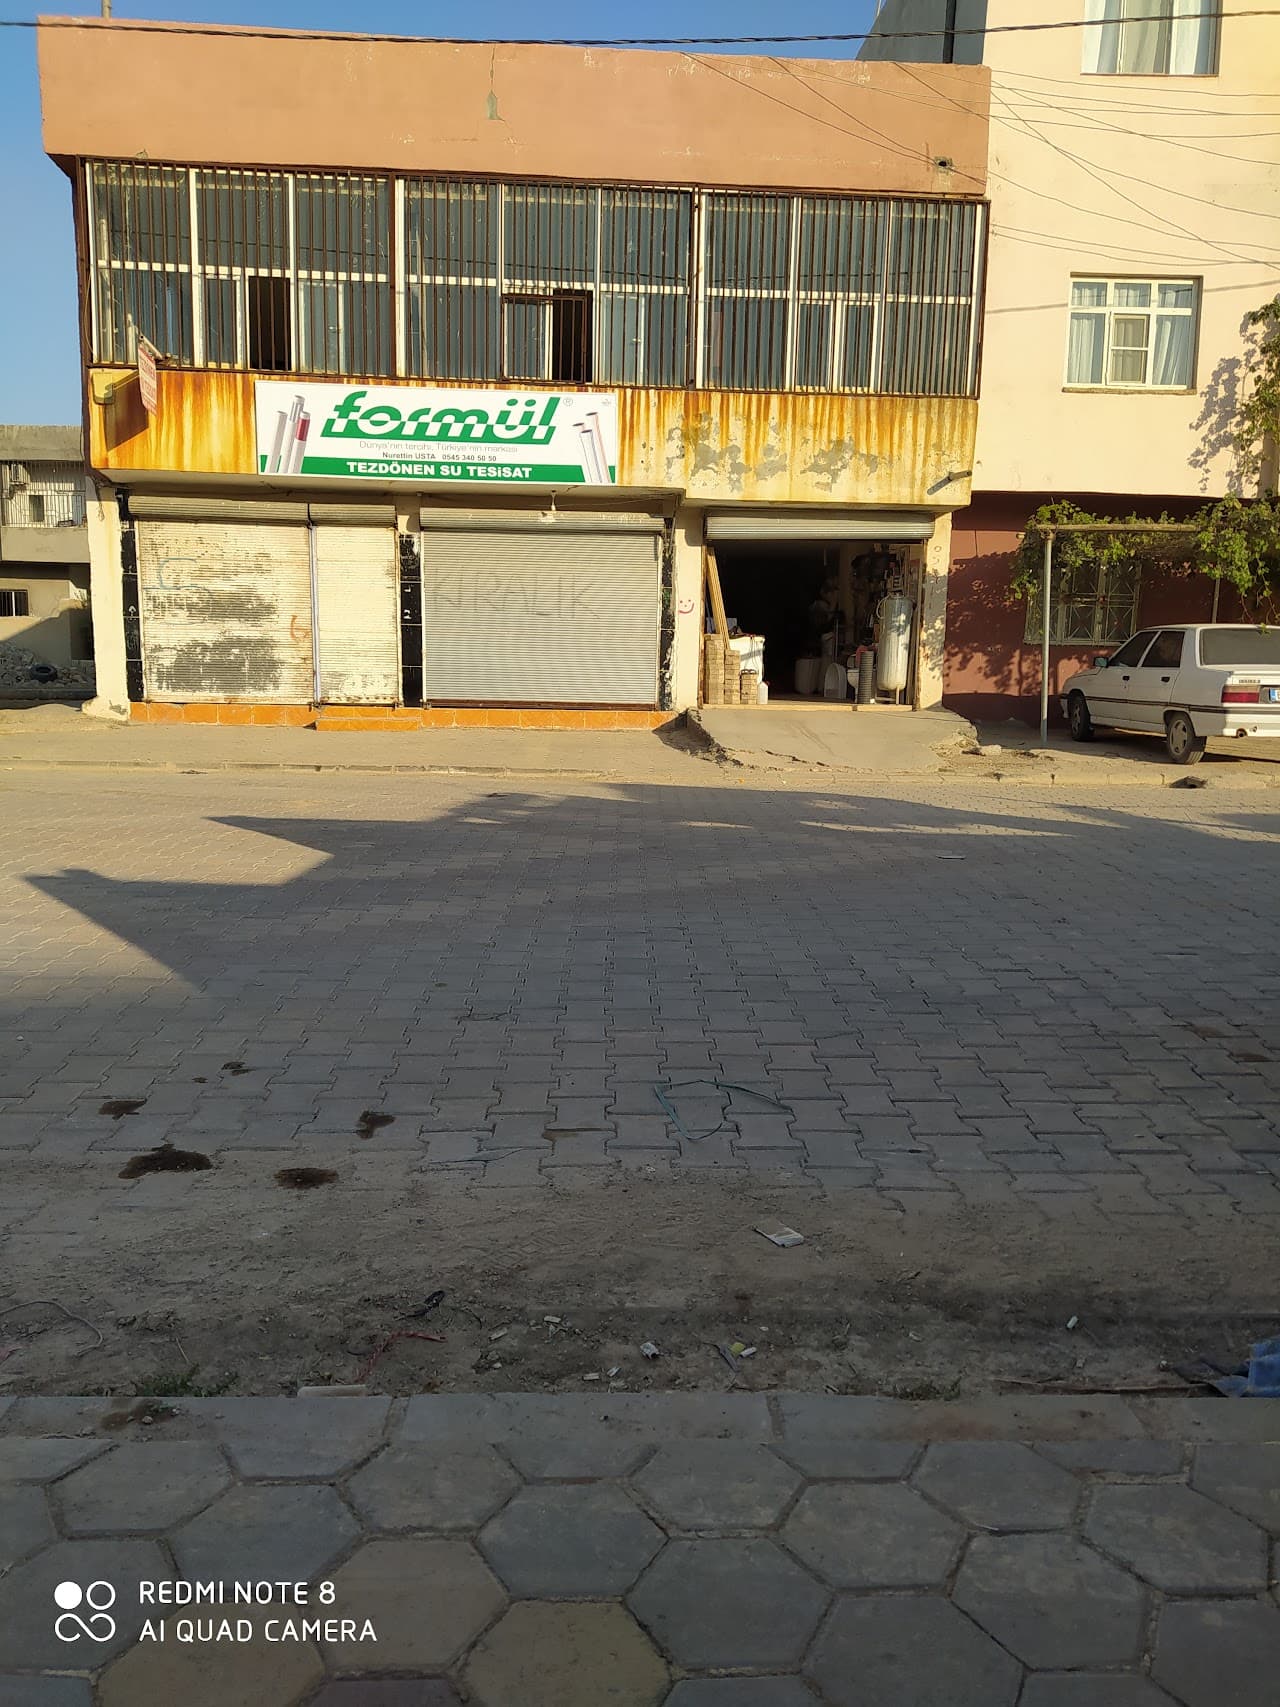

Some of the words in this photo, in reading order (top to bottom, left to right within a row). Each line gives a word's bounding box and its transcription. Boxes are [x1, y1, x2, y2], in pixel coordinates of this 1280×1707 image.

[321, 390, 561, 443] formül
[382, 451, 413, 459] Nurettin
[346, 461, 436, 476] TEZDÖNEN
[440, 465, 462, 477] SU
